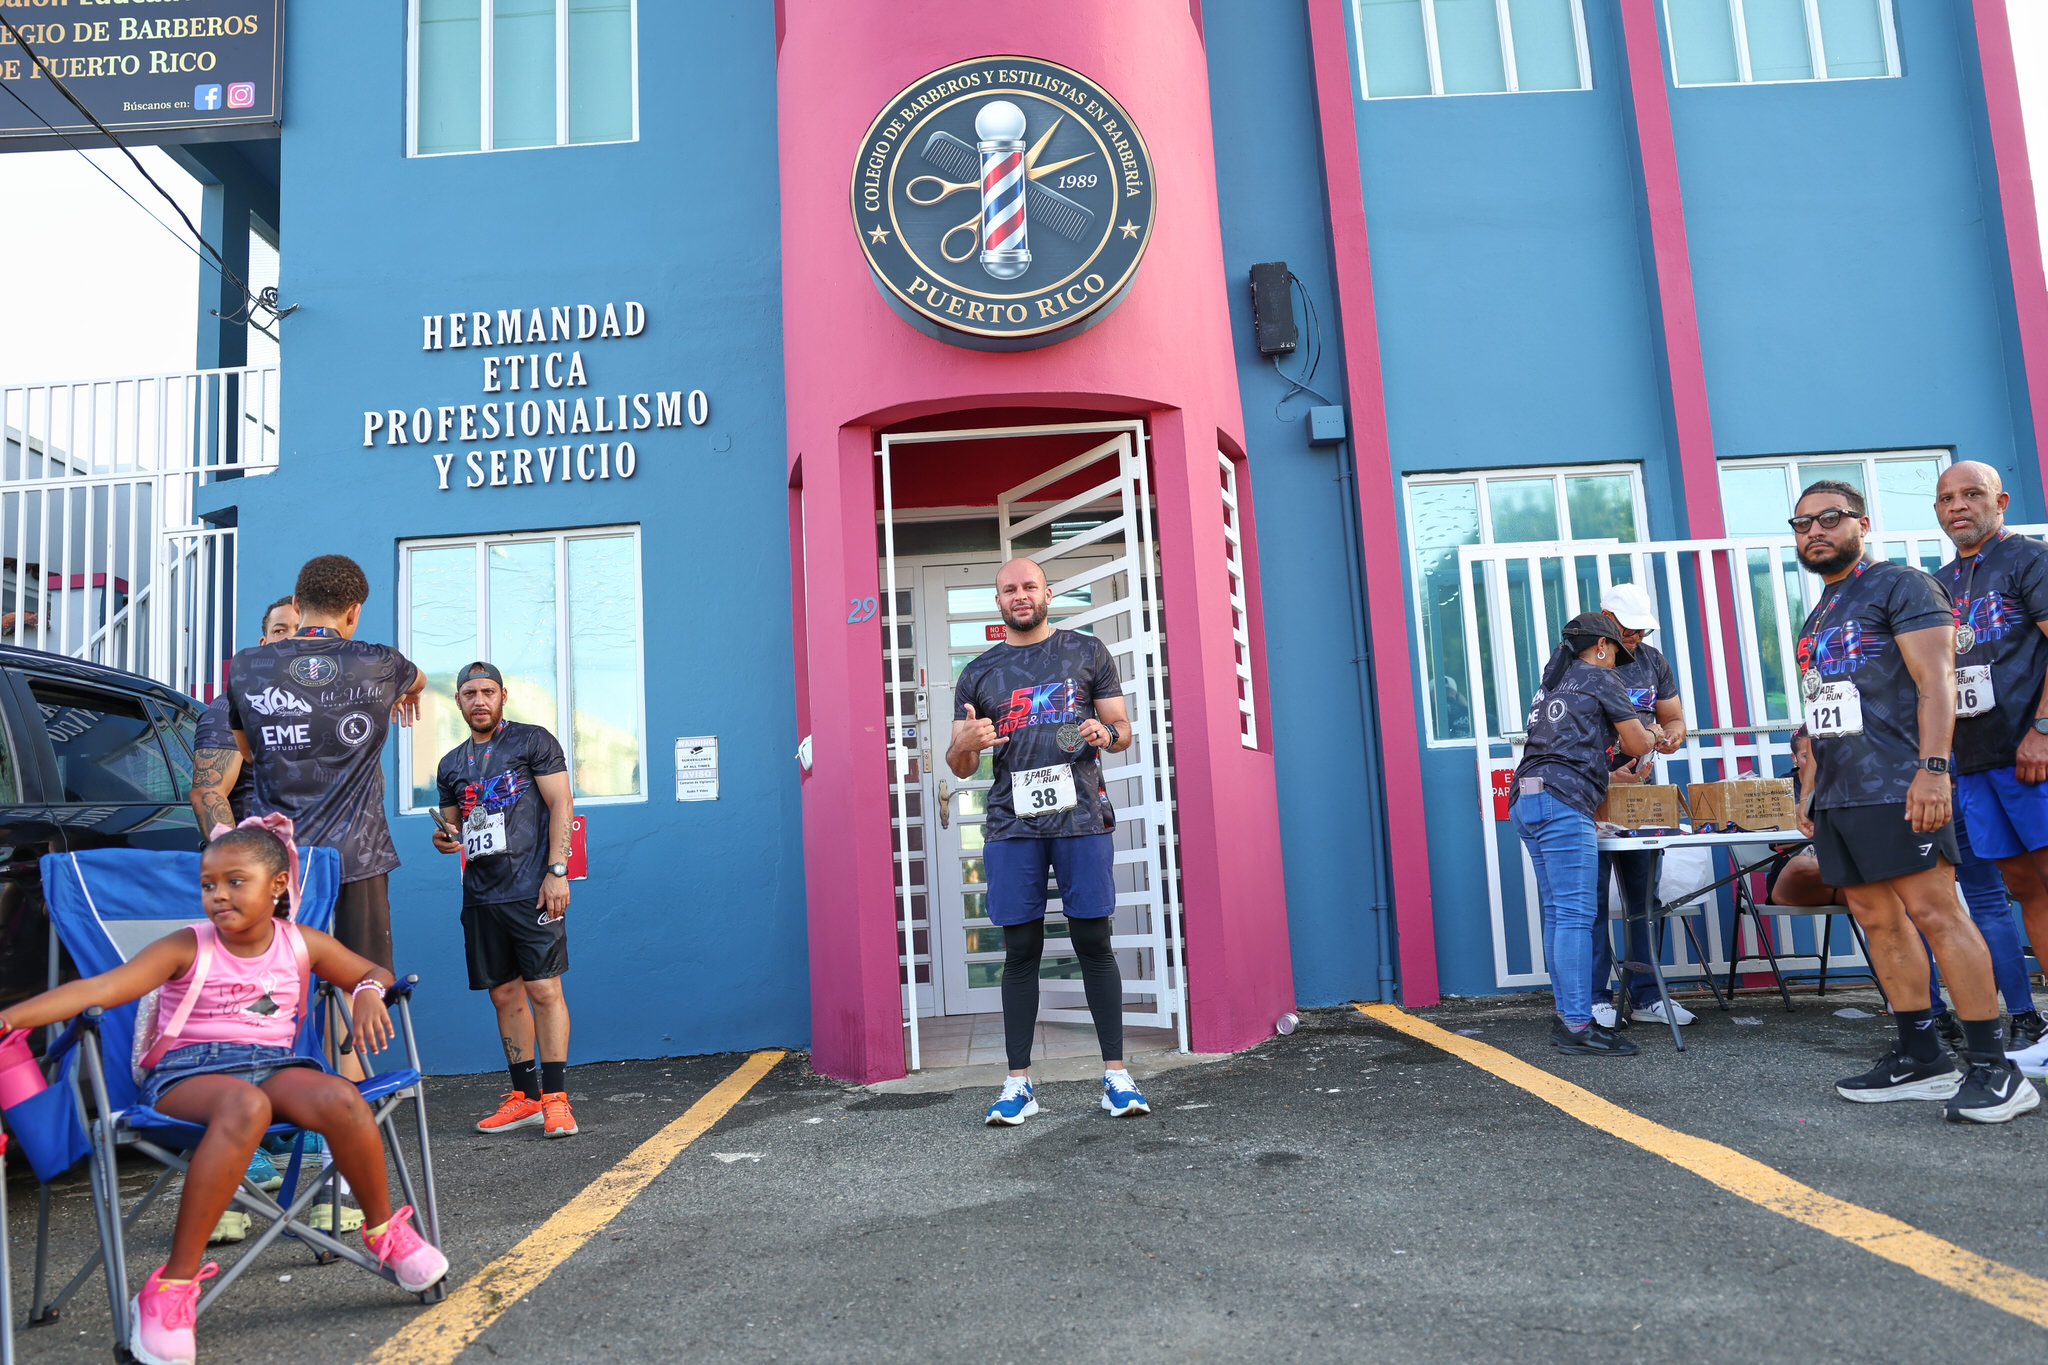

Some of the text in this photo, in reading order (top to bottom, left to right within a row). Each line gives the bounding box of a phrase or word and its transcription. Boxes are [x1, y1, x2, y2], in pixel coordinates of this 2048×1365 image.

[73, 21, 110, 43] DE
[118, 14, 259, 41] BARBEROS
[0, 50, 217, 81] E PUERTO RICO
[123, 100, 190, 112] Búscanos en:
[865, 69, 1144, 212] COLEGIO DE BARBEROS Y ESTILISTAS EN BARBERÍA
[1057, 174, 1098, 190] 1989
[906, 273, 1106, 323] PUERTO RICO
[422, 301, 646, 350] HERMANDAD
[482, 350, 588, 392] ETICA
[362, 389, 710, 447] PROFESIONALISMO
[432, 441, 637, 490] Y SERVICIO
[847, 597, 878, 625] 29
[1974, 627, 2002, 645] UN
[1955, 669, 1966, 679] DE
[1957, 676, 1975, 685] RUN
[1008, 683, 1064, 719] 5K
[1820, 685, 1836, 695] ADE
[1826, 693, 1843, 702] RUN
[998, 711, 1074, 737] FADE & RUN
[1813, 706, 1842, 730] 121
[261, 724, 311, 745] EME
[682, 770, 712, 778] AVISO
[1030, 768, 1052, 779] FADE
[1042, 774, 1060, 784] RUN
[1031, 787, 1058, 809] 38
[1492, 787, 1510, 797] PAR
[467, 833, 493, 855] 213
